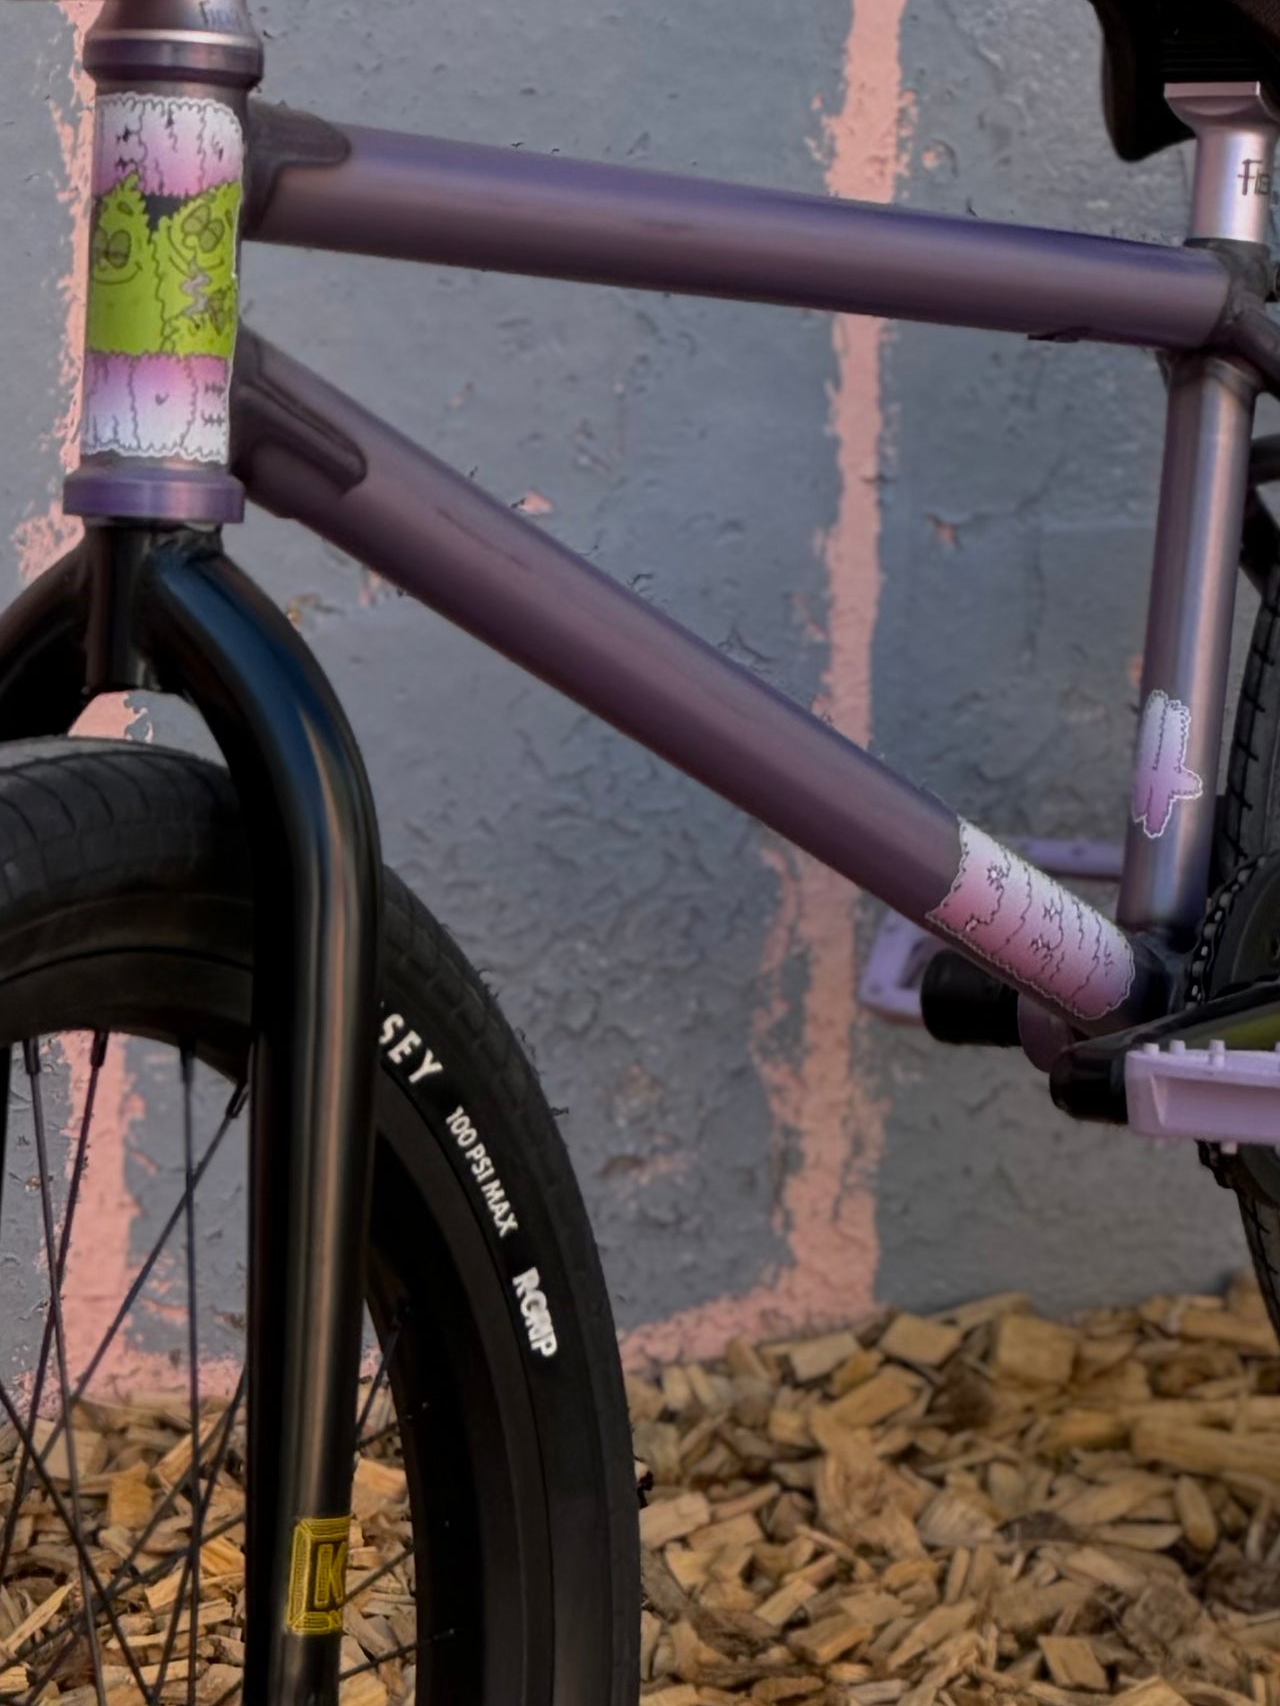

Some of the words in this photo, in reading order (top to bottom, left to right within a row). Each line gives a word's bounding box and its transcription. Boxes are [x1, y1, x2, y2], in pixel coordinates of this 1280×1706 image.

[377, 1011, 444, 1084] SEY
[445, 1104, 478, 1148] 100
[464, 1142, 495, 1183] PSI
[480, 1178, 519, 1238] MAX
